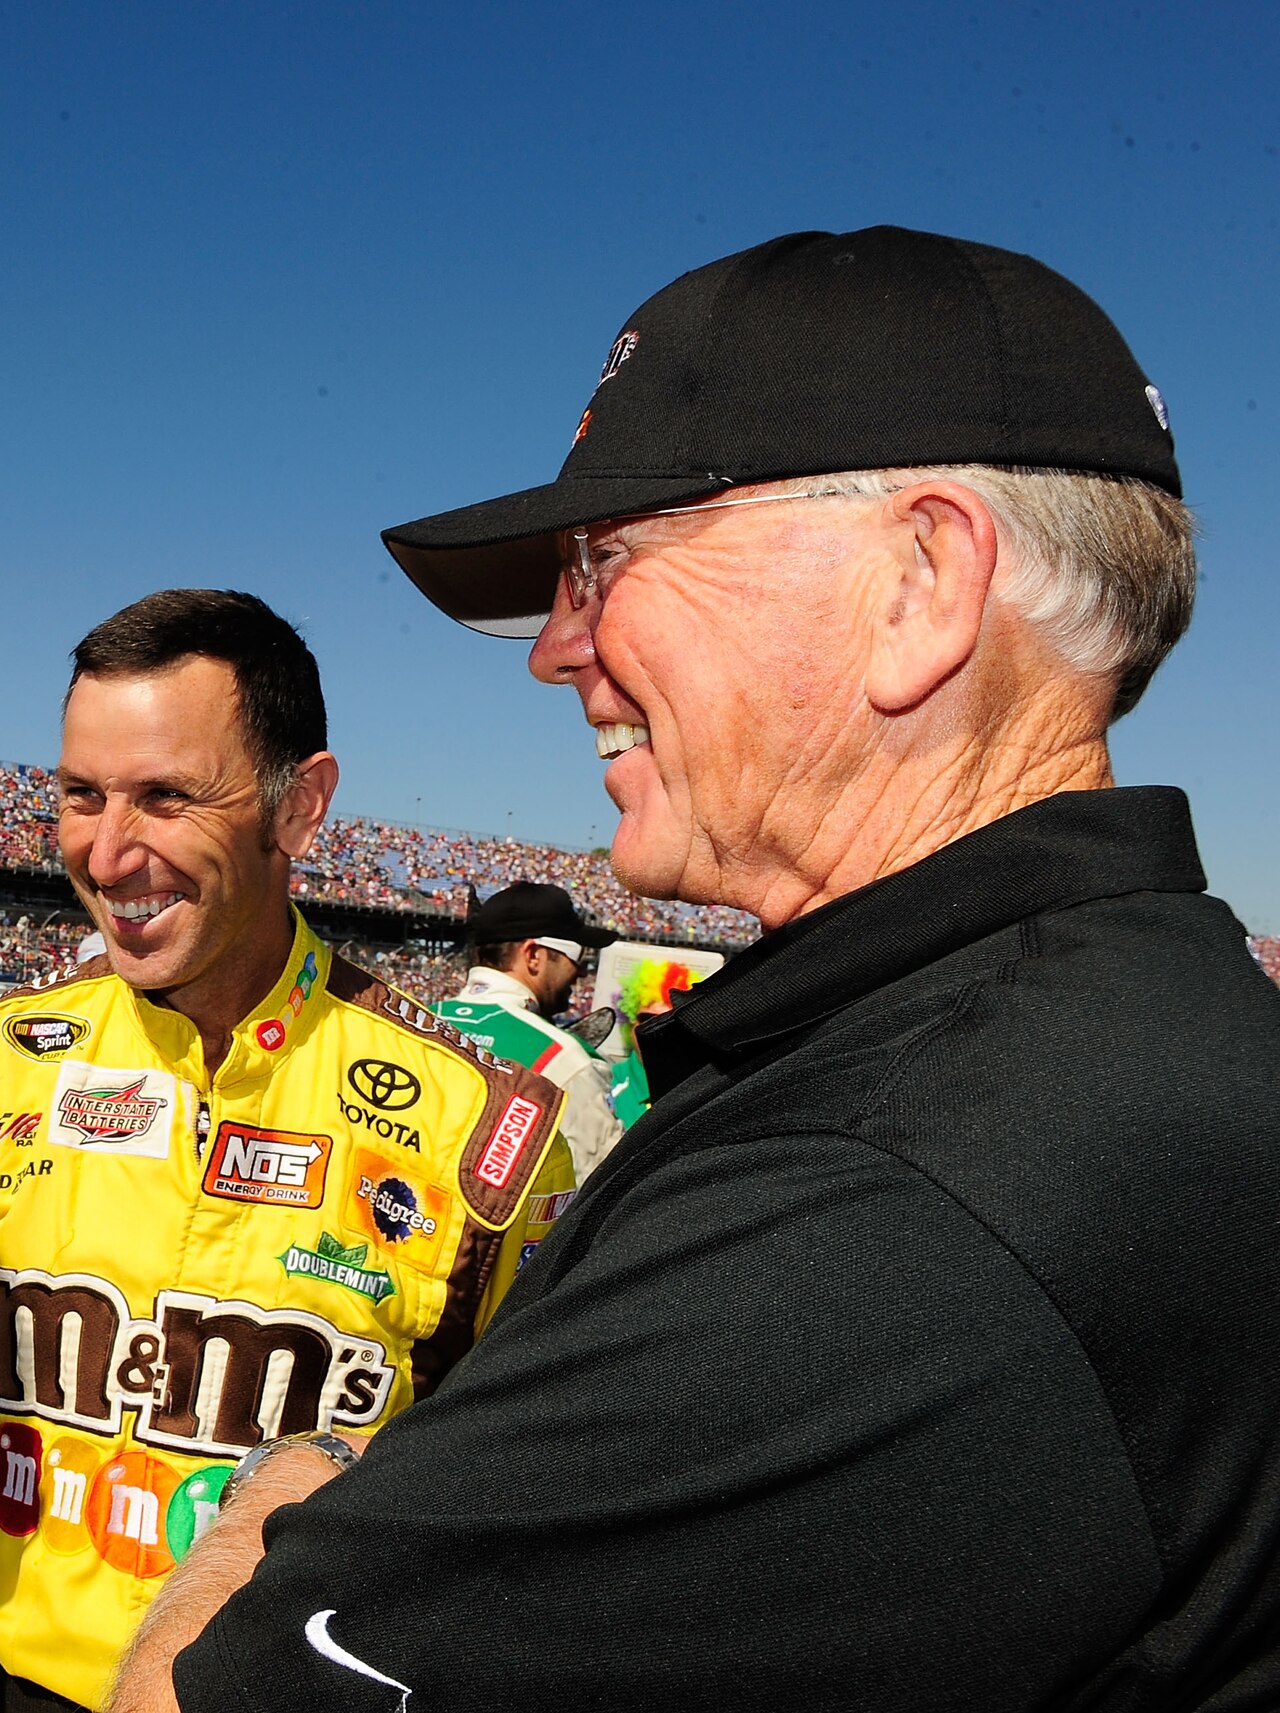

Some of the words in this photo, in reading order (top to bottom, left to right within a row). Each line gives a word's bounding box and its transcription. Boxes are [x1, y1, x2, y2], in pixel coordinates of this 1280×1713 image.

[29, 1022, 70, 1036] NASCAR
[36, 1034, 72, 1051] Sprint
[68, 1096, 155, 1116] INTERSTATE
[69, 1112, 147, 1130] BATTERIES
[337, 1091, 422, 1154] TOYOTA
[220, 1134, 318, 1186] NOS
[482, 1101, 534, 1180] SIMPSON
[215, 1179, 266, 1199] ENERGY
[266, 1187, 309, 1202] DRINK
[356, 1175, 437, 1236] Pedigree
[285, 1247, 390, 1298] DOUBLEMINT
[3, 1450, 37, 1508] m
[51, 1464, 87, 1525] m
[106, 1480, 159, 1547] m
